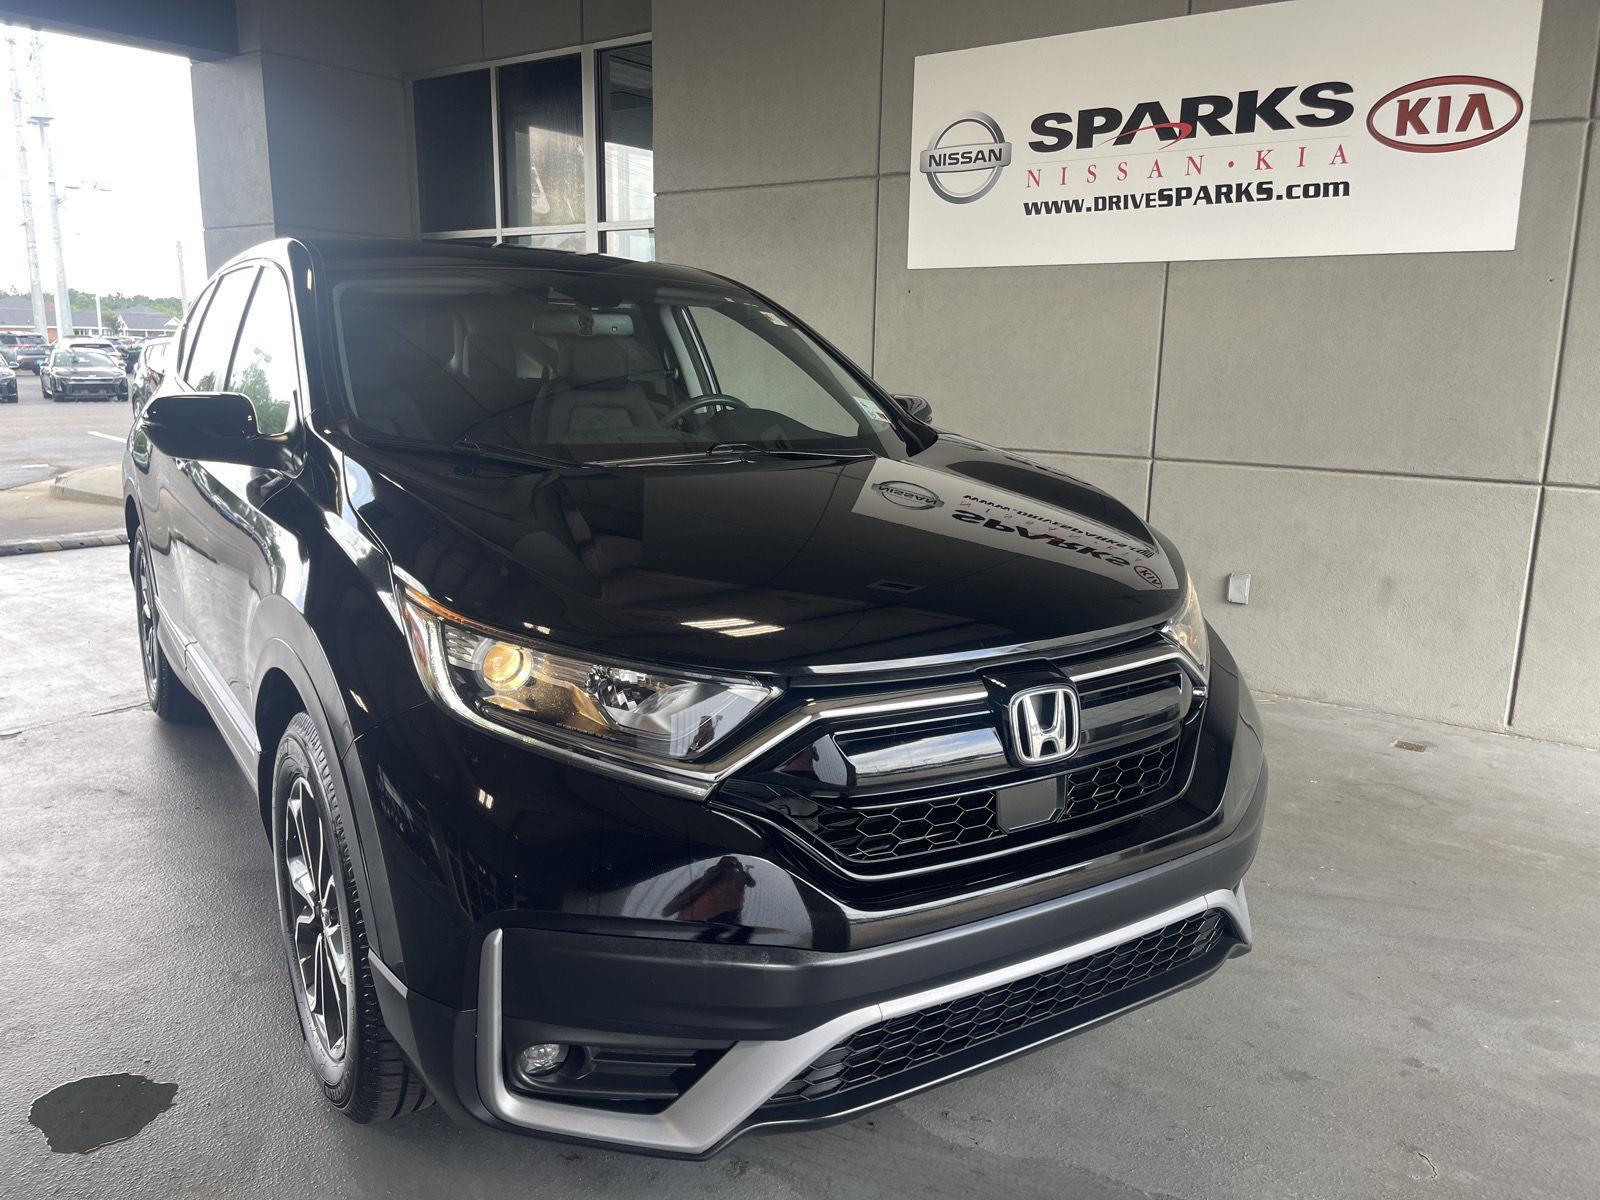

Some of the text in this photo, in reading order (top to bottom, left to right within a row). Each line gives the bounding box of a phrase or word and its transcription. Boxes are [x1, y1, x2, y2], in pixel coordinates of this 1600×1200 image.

[1028, 81, 1354, 153] SPARKS
[1395, 92, 1494, 137] KIA
[928, 147, 1003, 168] NISSAN
[1025, 143, 1349, 189] NISSAN KIA
[1023, 180, 1351, 216] www.DRIVESPARKS.com
